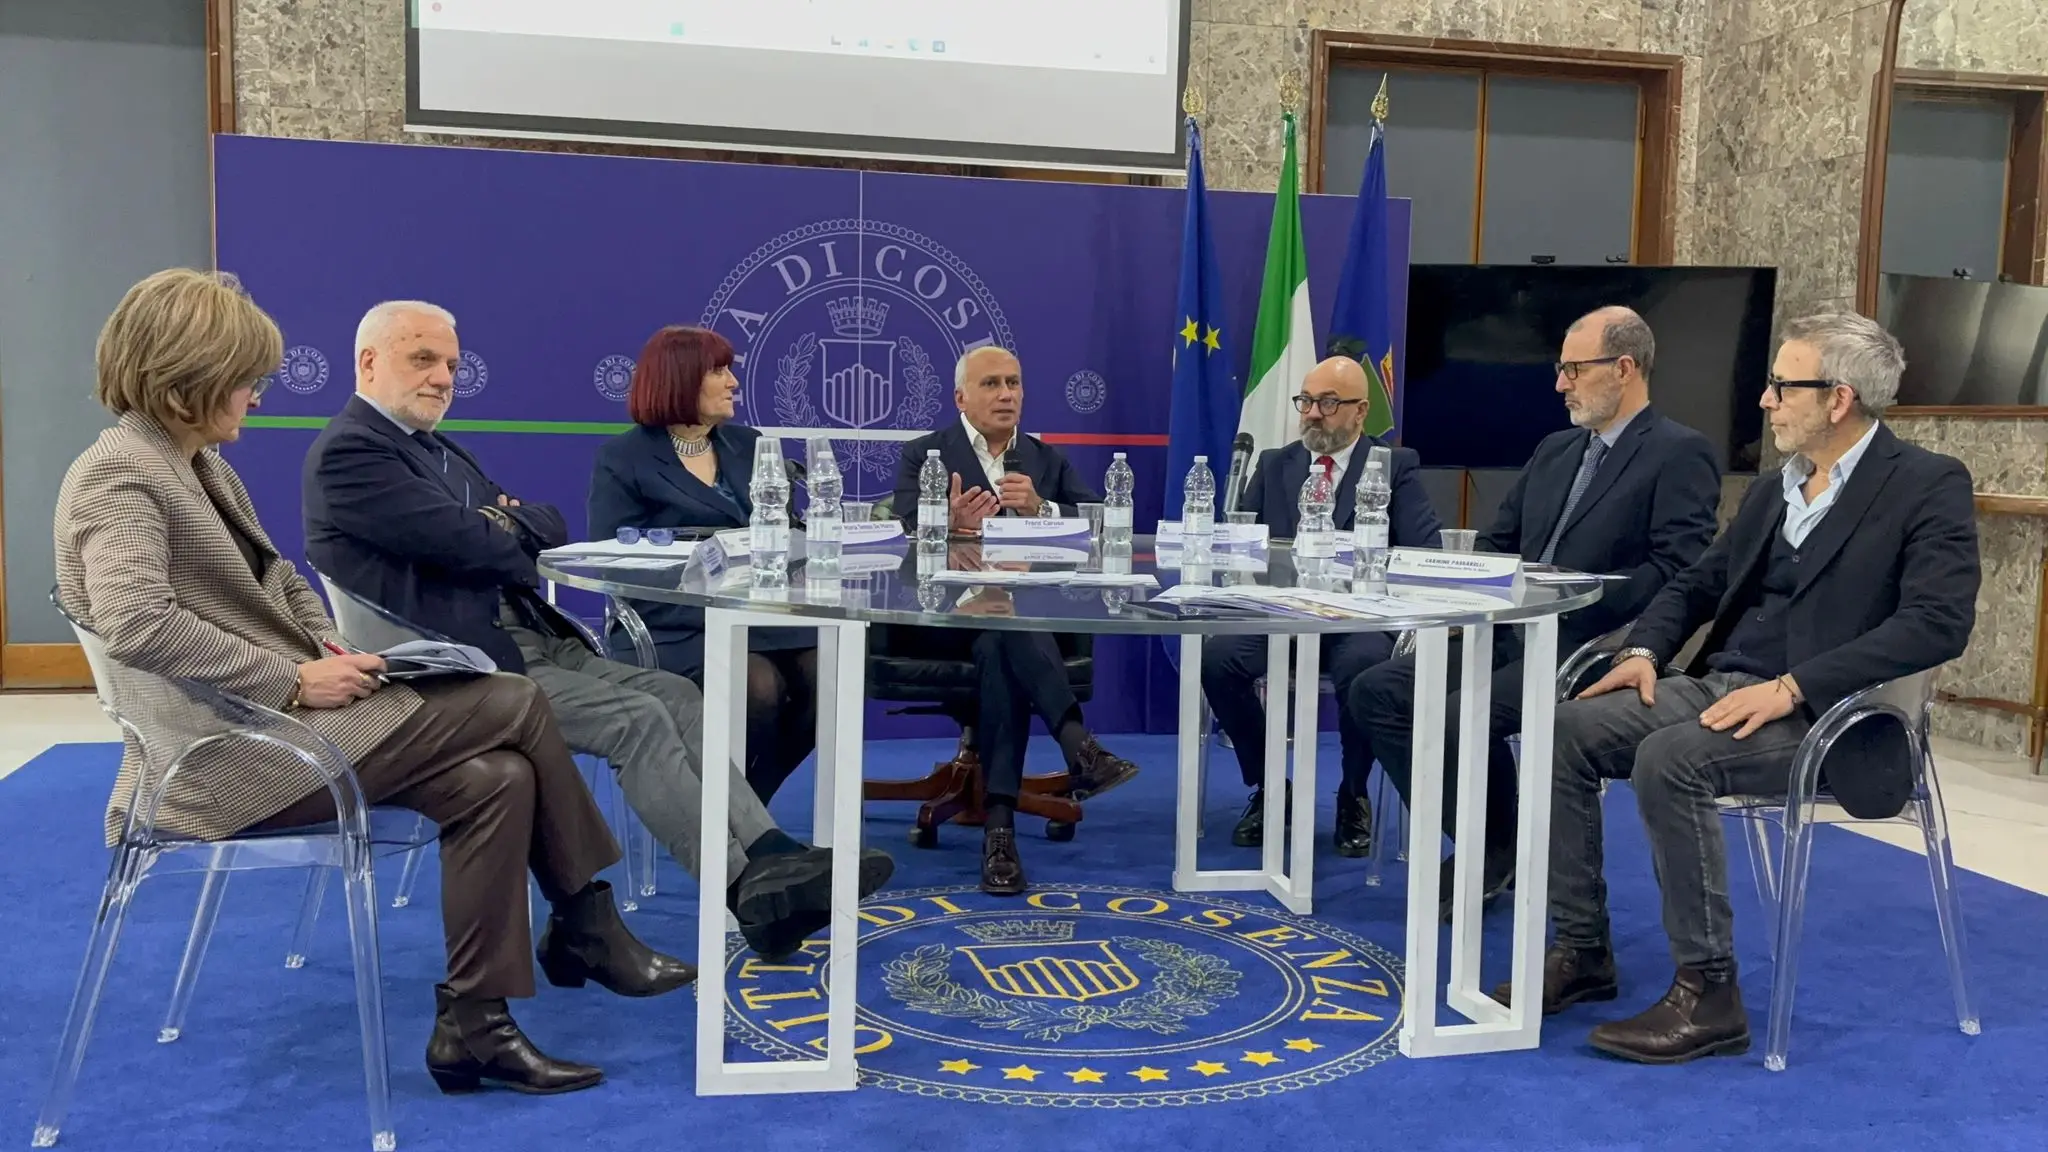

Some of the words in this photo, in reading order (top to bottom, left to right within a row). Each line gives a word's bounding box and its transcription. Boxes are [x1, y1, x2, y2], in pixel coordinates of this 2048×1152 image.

[771, 241, 843, 296] DI
[738, 939, 893, 1054] CITT
[858, 896, 973, 928] DI
[1026, 890, 1388, 1023] COSENZA
